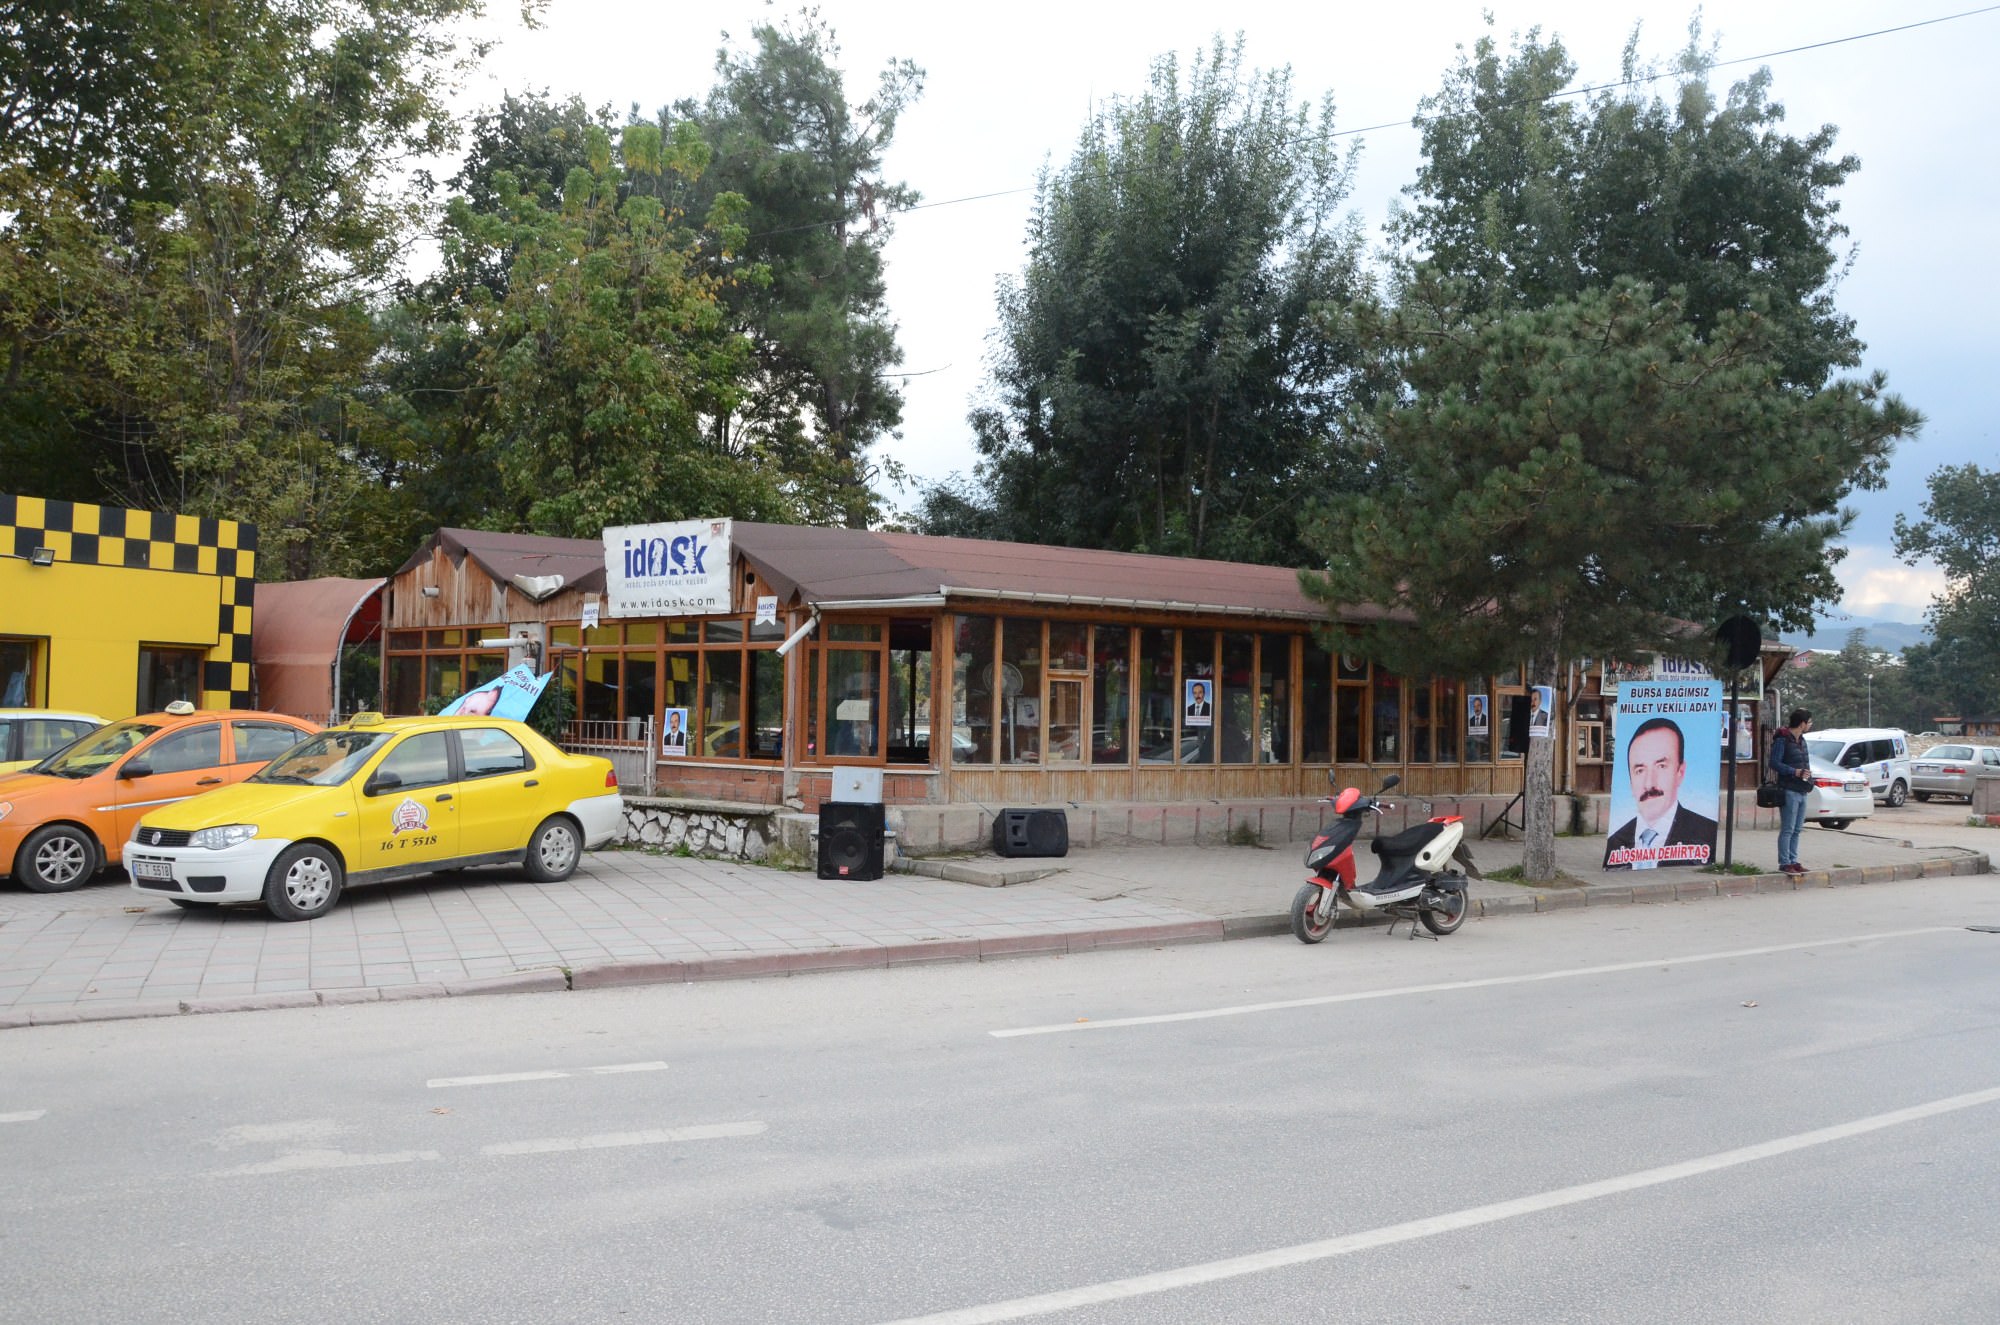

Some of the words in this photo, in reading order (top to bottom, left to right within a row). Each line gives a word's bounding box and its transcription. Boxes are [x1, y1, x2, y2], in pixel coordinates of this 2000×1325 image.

[1630, 688, 1662, 698] BURSA
[1665, 685, 1710, 698] BAĞIMSIZ
[1620, 701, 1654, 713] MİLLET
[1656, 700, 1687, 713] VEKİLİ
[1688, 702, 1717, 713] ADAYI
[380, 840, 394, 851] 16
[400, 839, 409, 849] T
[412, 835, 438, 847] 5518
[1608, 846, 1657, 865] ALİOSMAN
[1657, 842, 1710, 864] DEMİRTAŞ
